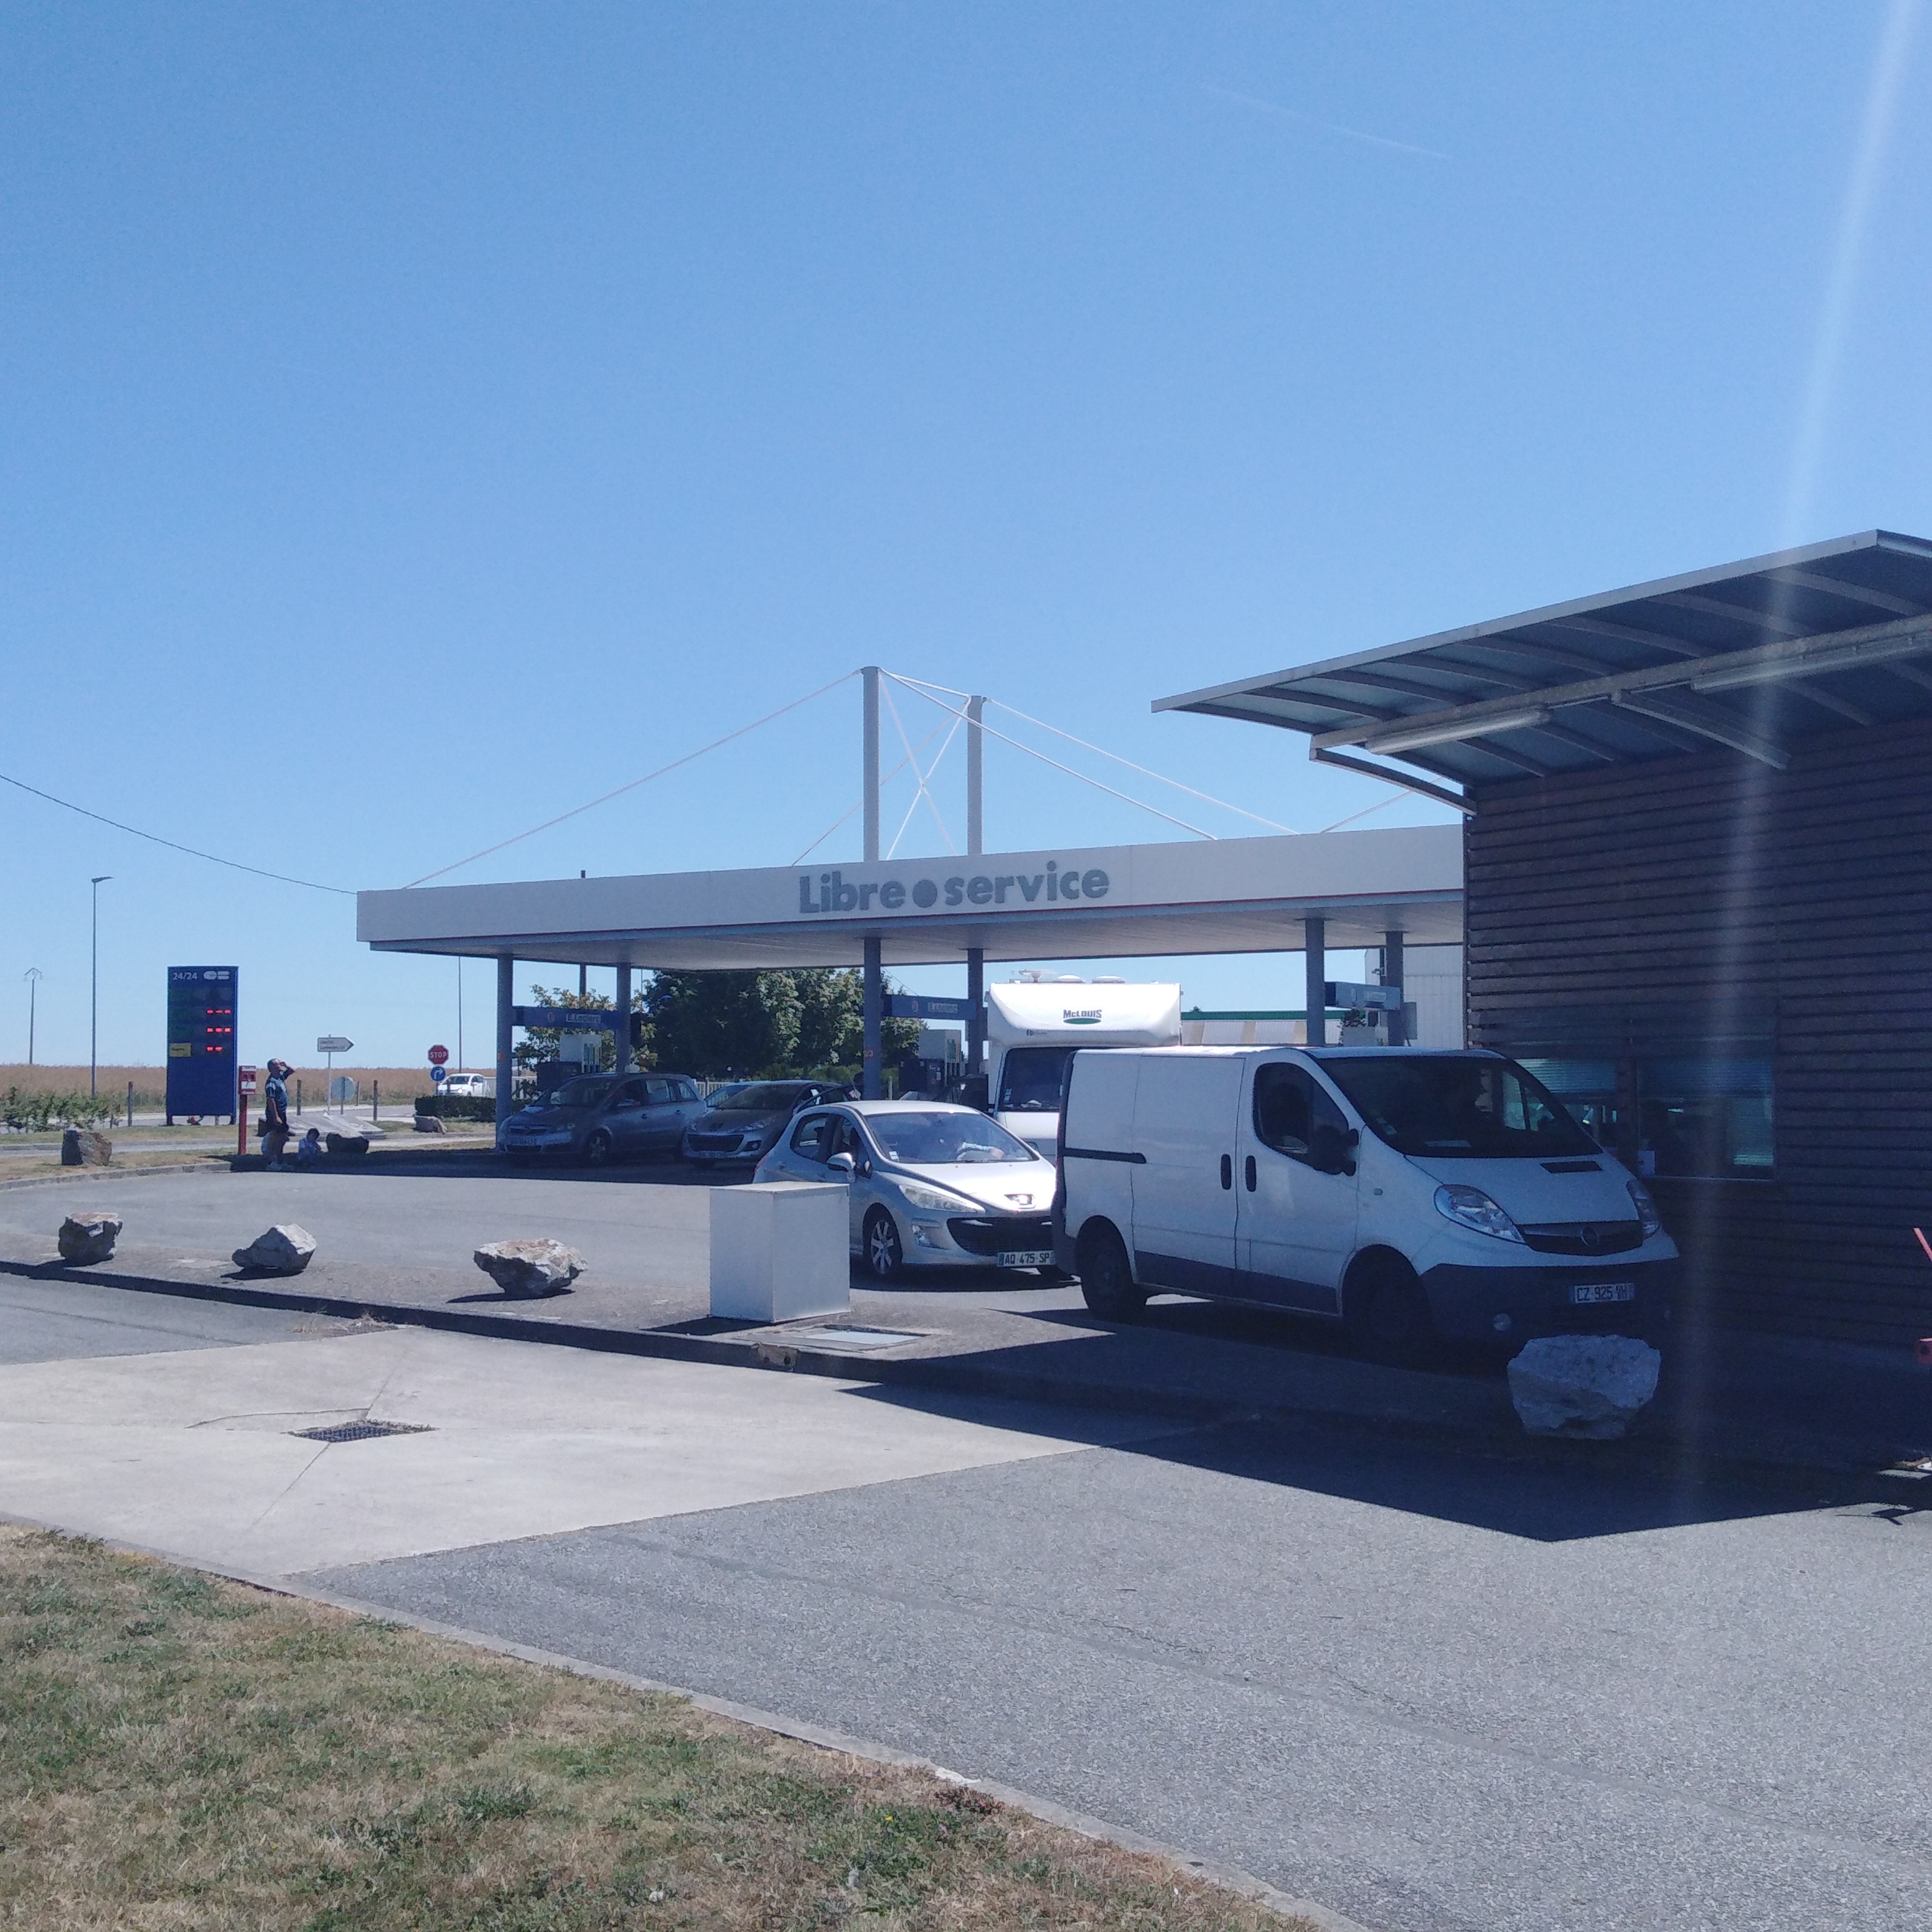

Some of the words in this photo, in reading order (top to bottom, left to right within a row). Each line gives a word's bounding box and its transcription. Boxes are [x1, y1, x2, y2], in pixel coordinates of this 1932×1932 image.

[799, 871, 906, 914] Libre
[944, 860, 1110, 907] service
[172, 972, 198, 980] 24/24
[429, 1051, 447, 1059] STOP
